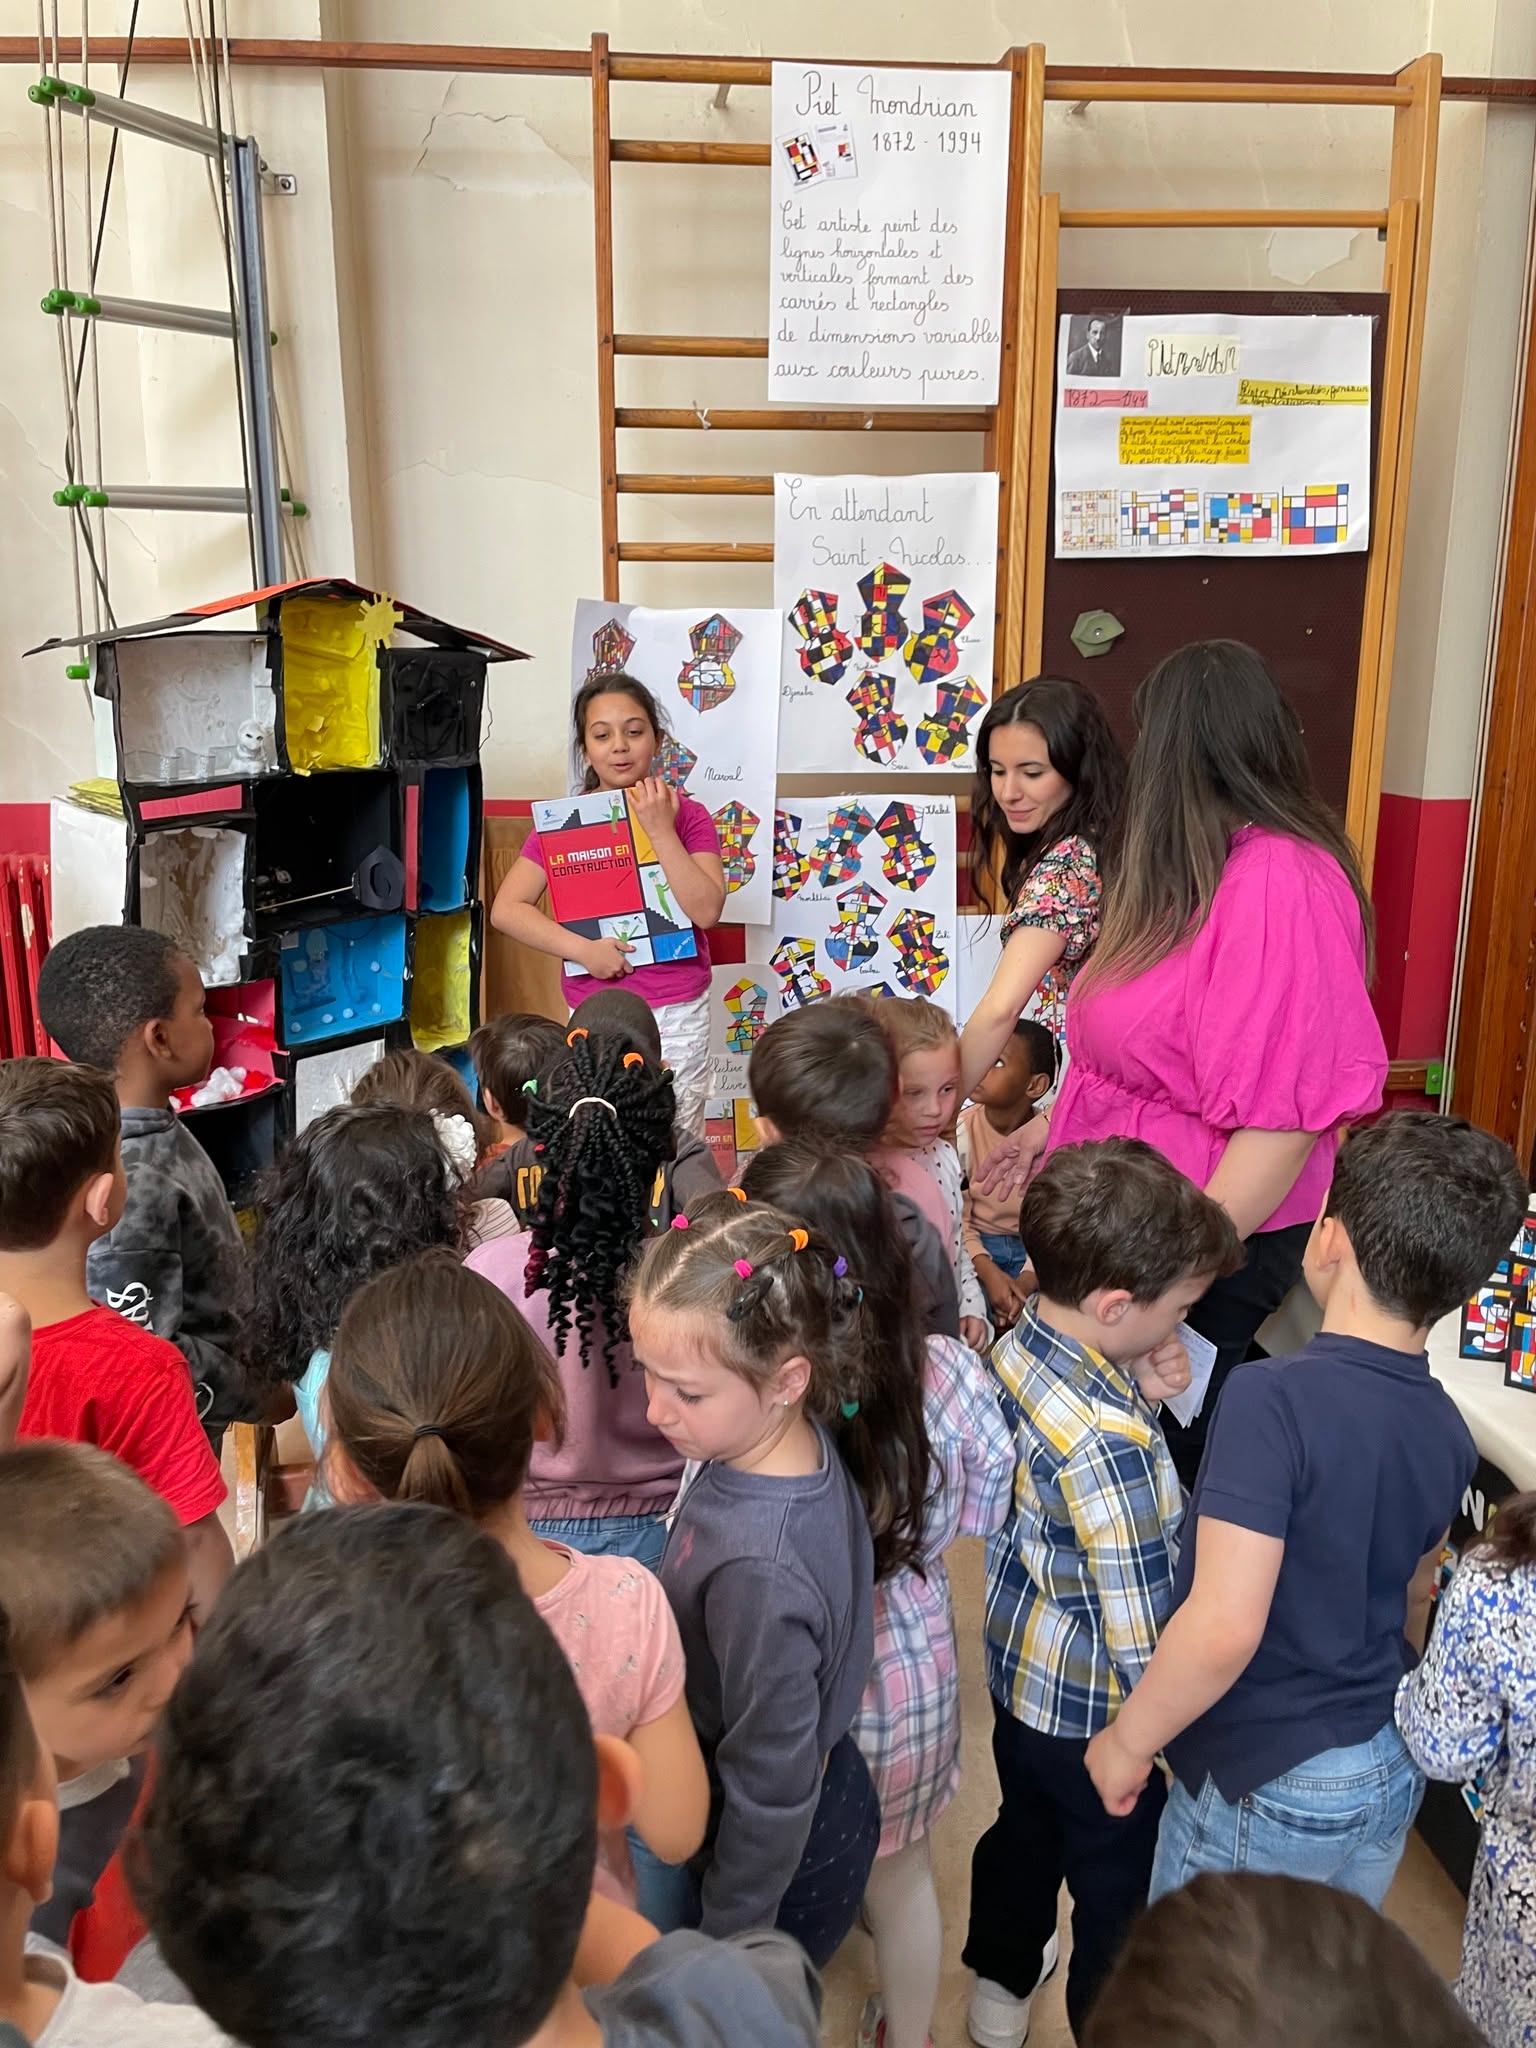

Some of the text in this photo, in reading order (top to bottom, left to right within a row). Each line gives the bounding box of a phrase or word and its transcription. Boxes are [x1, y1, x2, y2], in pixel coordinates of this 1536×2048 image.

[796, 70, 977, 117] Piet Mondrian
[873, 131, 916, 153] 1872
[938, 131, 981, 154] 1994
[779, 200, 958, 243] Cet artiste peint des
[779, 237, 943, 270] lignes horizontales et
[780, 263, 974, 300] verticales formant des
[778, 287, 950, 326] carrés et rectangles
[776, 316, 1000, 344] de dimensions variables
[774, 351, 985, 400] aux couleurs pures.
[784, 478, 935, 523] En attendant
[812, 535, 870, 566] Saint
[549, 844, 630, 866] LA MAISON EN
[552, 857, 632, 877] CONSTRUCTION
